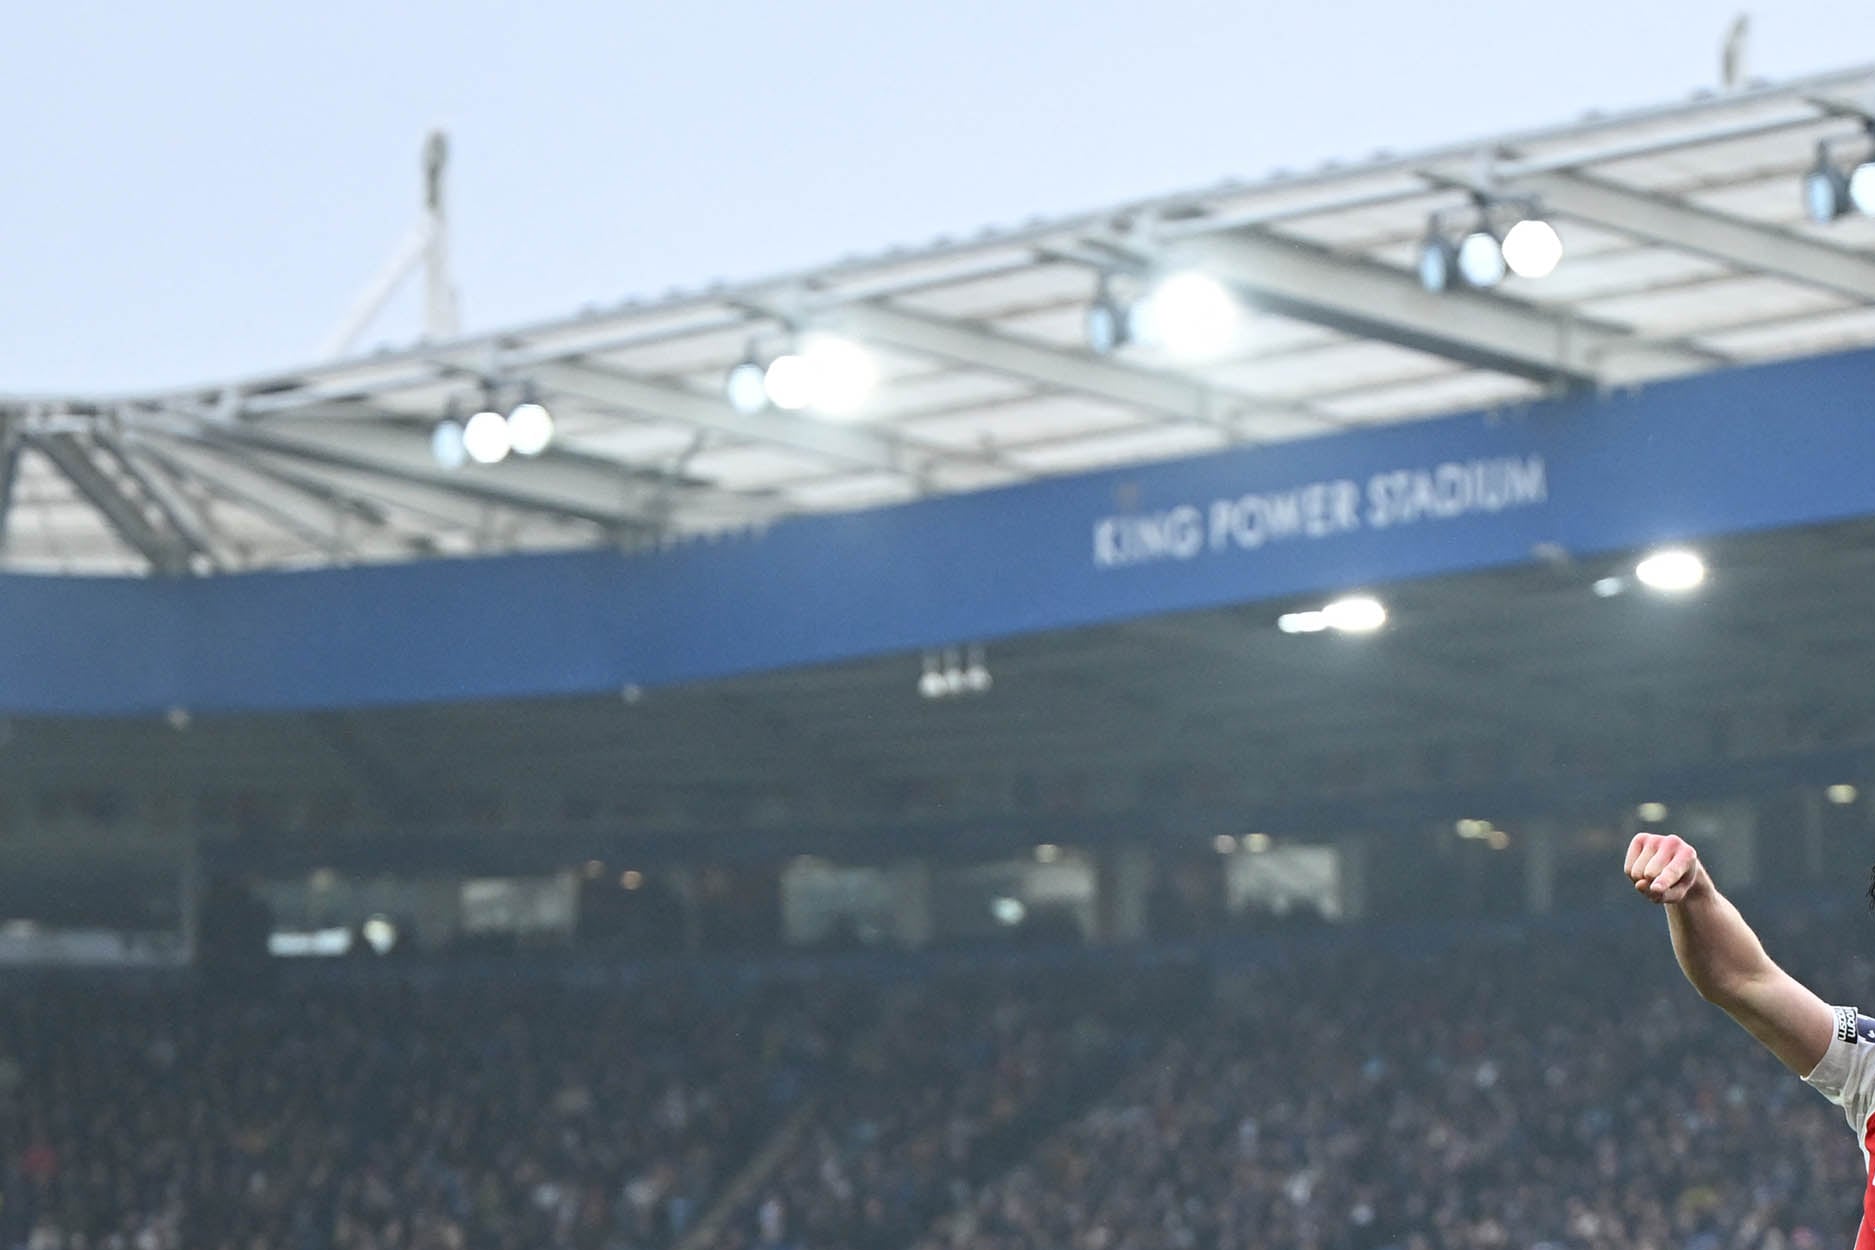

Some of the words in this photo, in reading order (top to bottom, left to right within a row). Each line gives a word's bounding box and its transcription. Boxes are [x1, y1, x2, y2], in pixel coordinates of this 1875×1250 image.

[1094, 504, 1203, 568] KING
[1207, 479, 1361, 552] POWER
[1367, 456, 1548, 530] STADIUM
